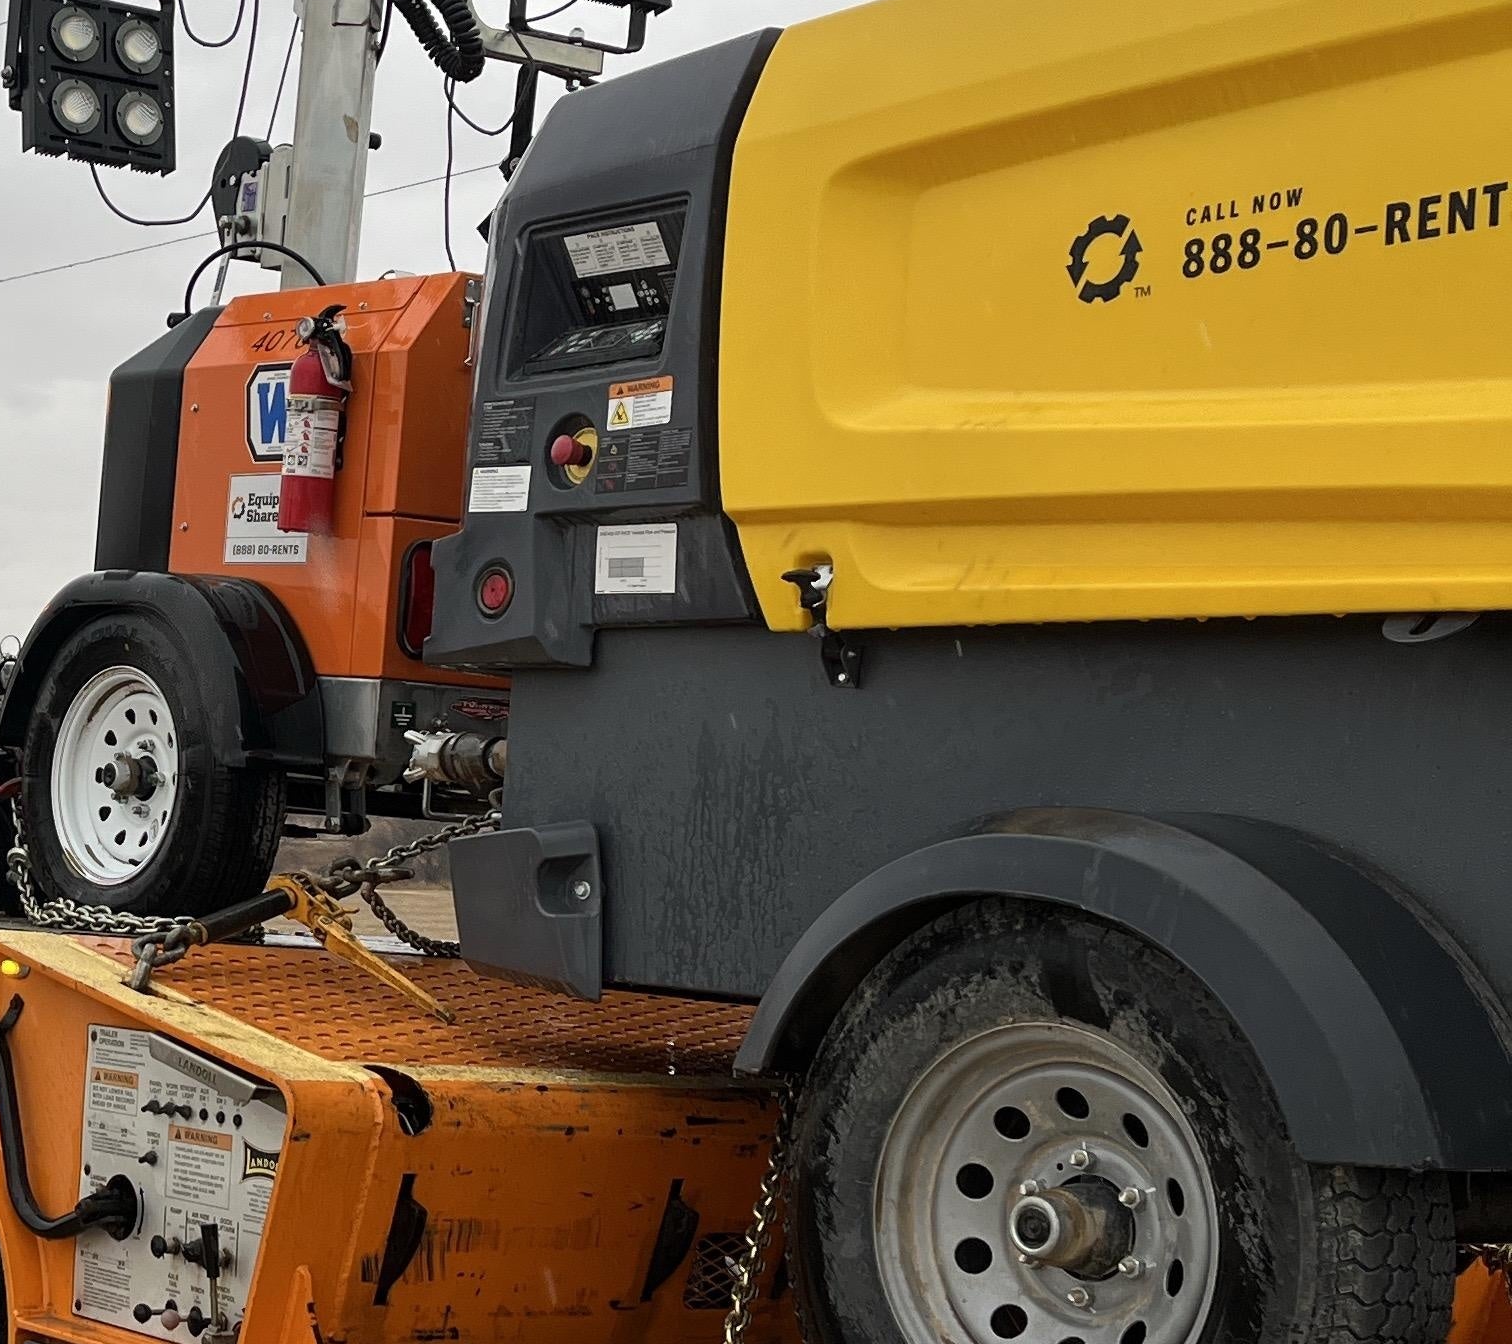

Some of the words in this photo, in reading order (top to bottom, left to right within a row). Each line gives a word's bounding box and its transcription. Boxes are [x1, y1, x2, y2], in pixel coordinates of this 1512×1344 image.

[1186, 199, 1240, 226] CALL
[1252, 187, 1304, 214] NOW
[1133, 285, 1152, 298] TM
[627, 380, 660, 393] WARNING
[257, 382, 287, 444] W
[246, 508, 279, 523] Share
[232, 544, 256, 556] (888)
[257, 544, 300, 555] 80-RENTS
[103, 1071, 135, 1086] WARNING
[178, 1057, 218, 1085] LANDOLL
[184, 1130, 218, 1145] WARNING
